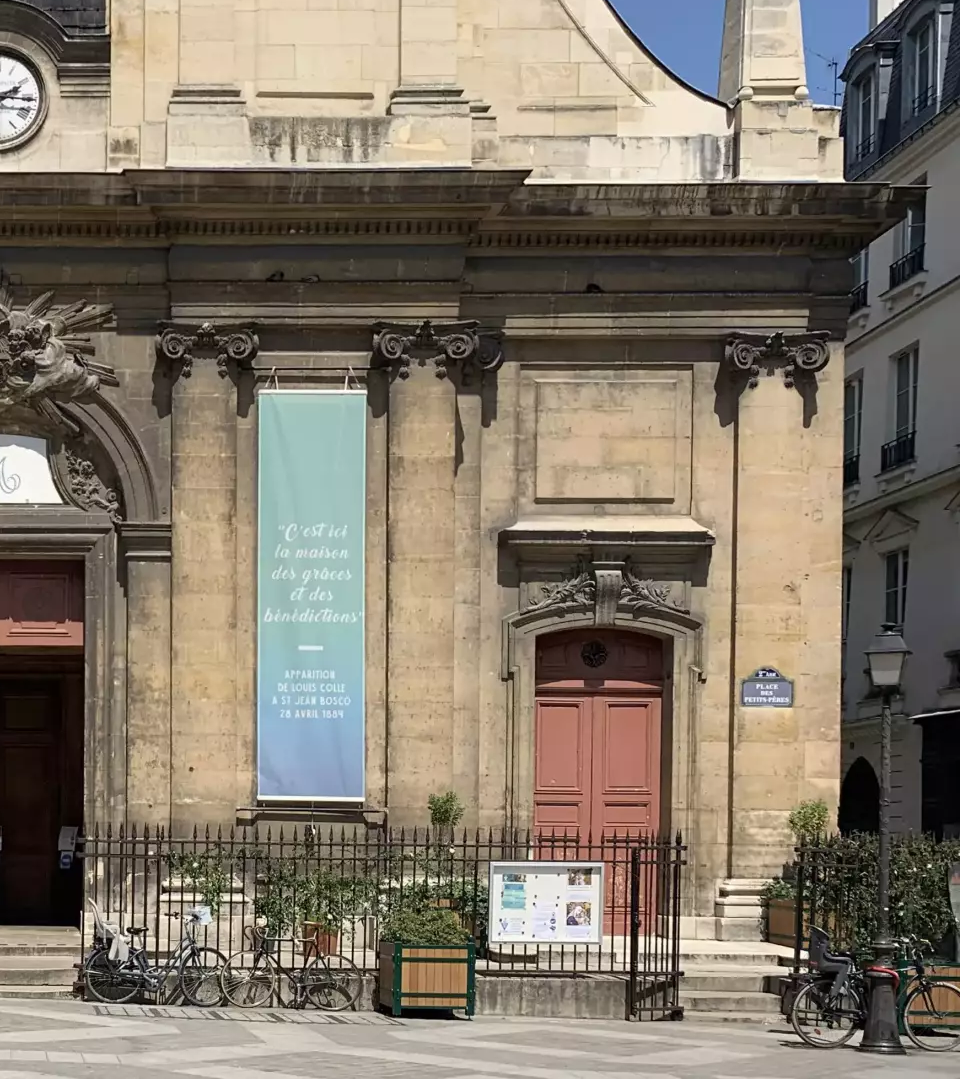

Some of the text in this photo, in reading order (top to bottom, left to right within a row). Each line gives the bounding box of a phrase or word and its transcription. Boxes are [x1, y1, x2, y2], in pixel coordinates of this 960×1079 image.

[328, 524, 349, 539] ici
[274, 543, 349, 559] la maison
[271, 564, 352, 585] des grâces
[290, 585, 333, 601] et des
[284, 669, 336, 679] APPARITION
[277, 683, 346, 693] DE LOUIS COLLE
[271, 696, 352, 706] A ST JEAN BOSCO
[280, 709, 344, 719] 28 AVRIL 1884
